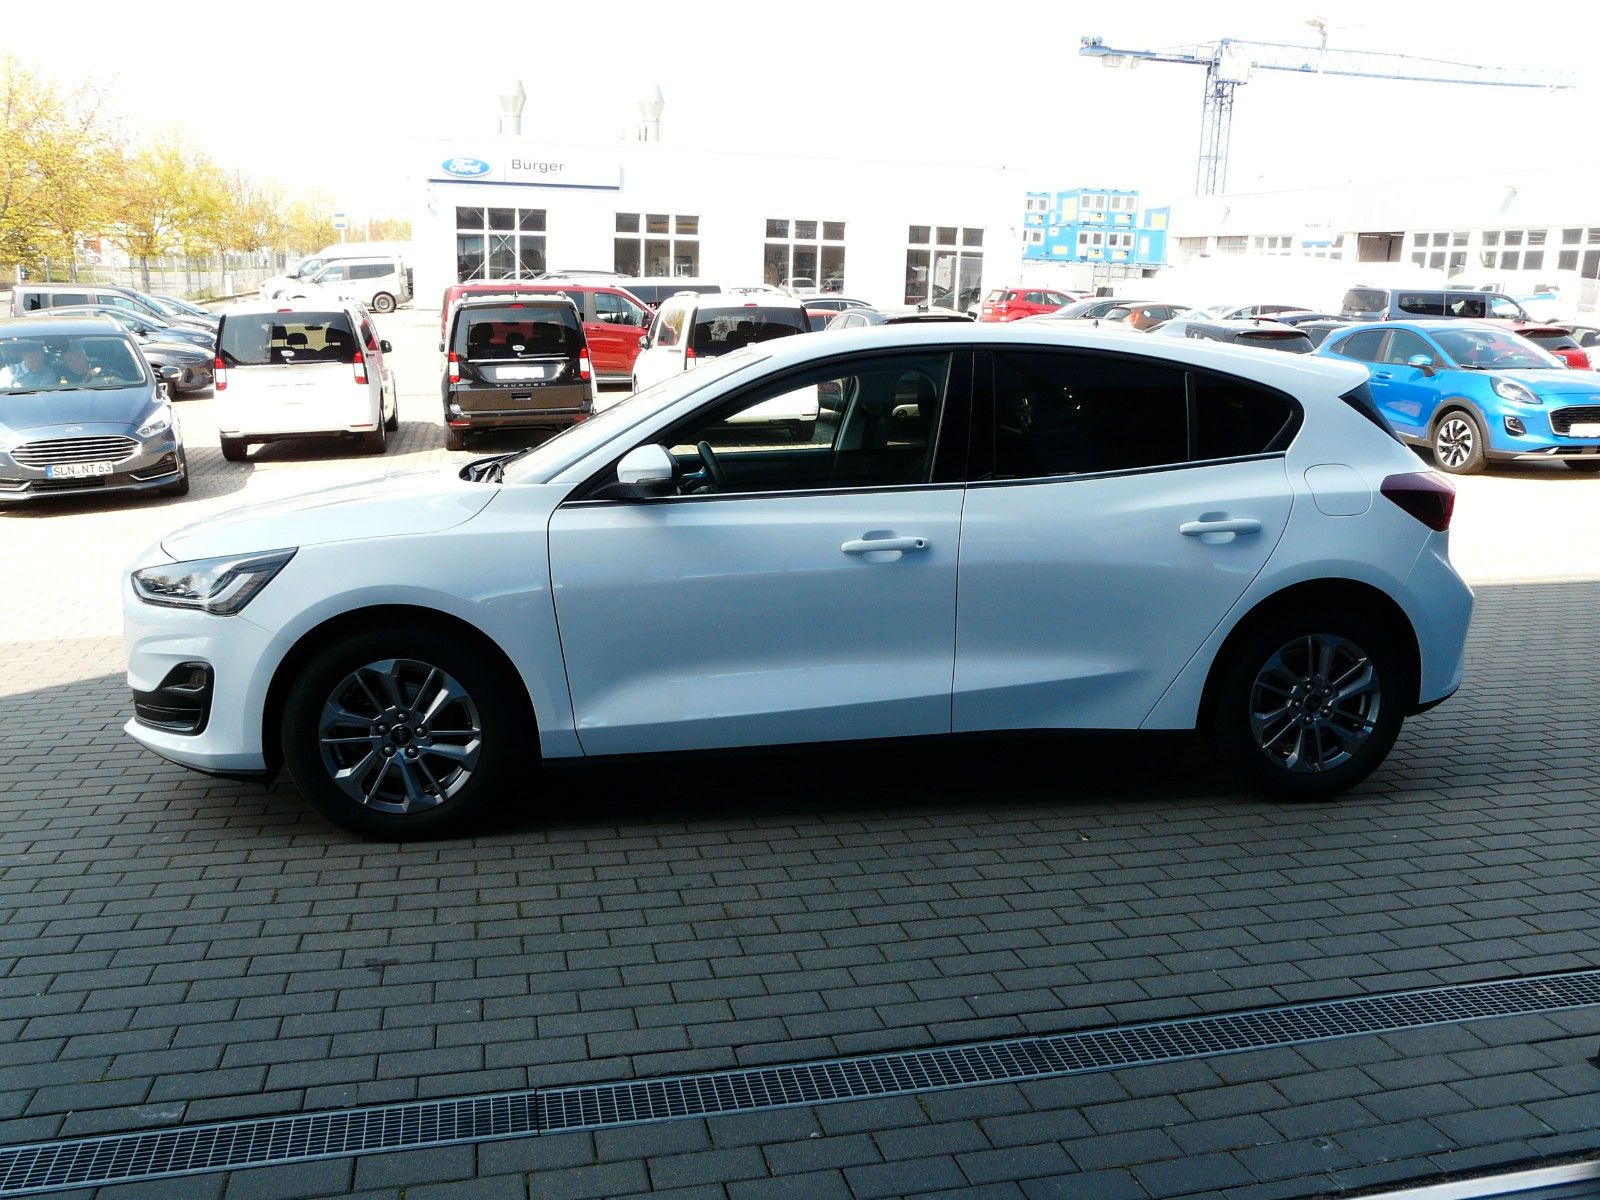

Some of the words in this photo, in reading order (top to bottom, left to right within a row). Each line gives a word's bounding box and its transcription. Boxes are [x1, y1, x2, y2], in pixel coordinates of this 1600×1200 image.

[449, 158, 482, 175] Ford
[53, 466, 75, 476] SLN
[81, 464, 96, 474] NT
[98, 462, 112, 473] 63
